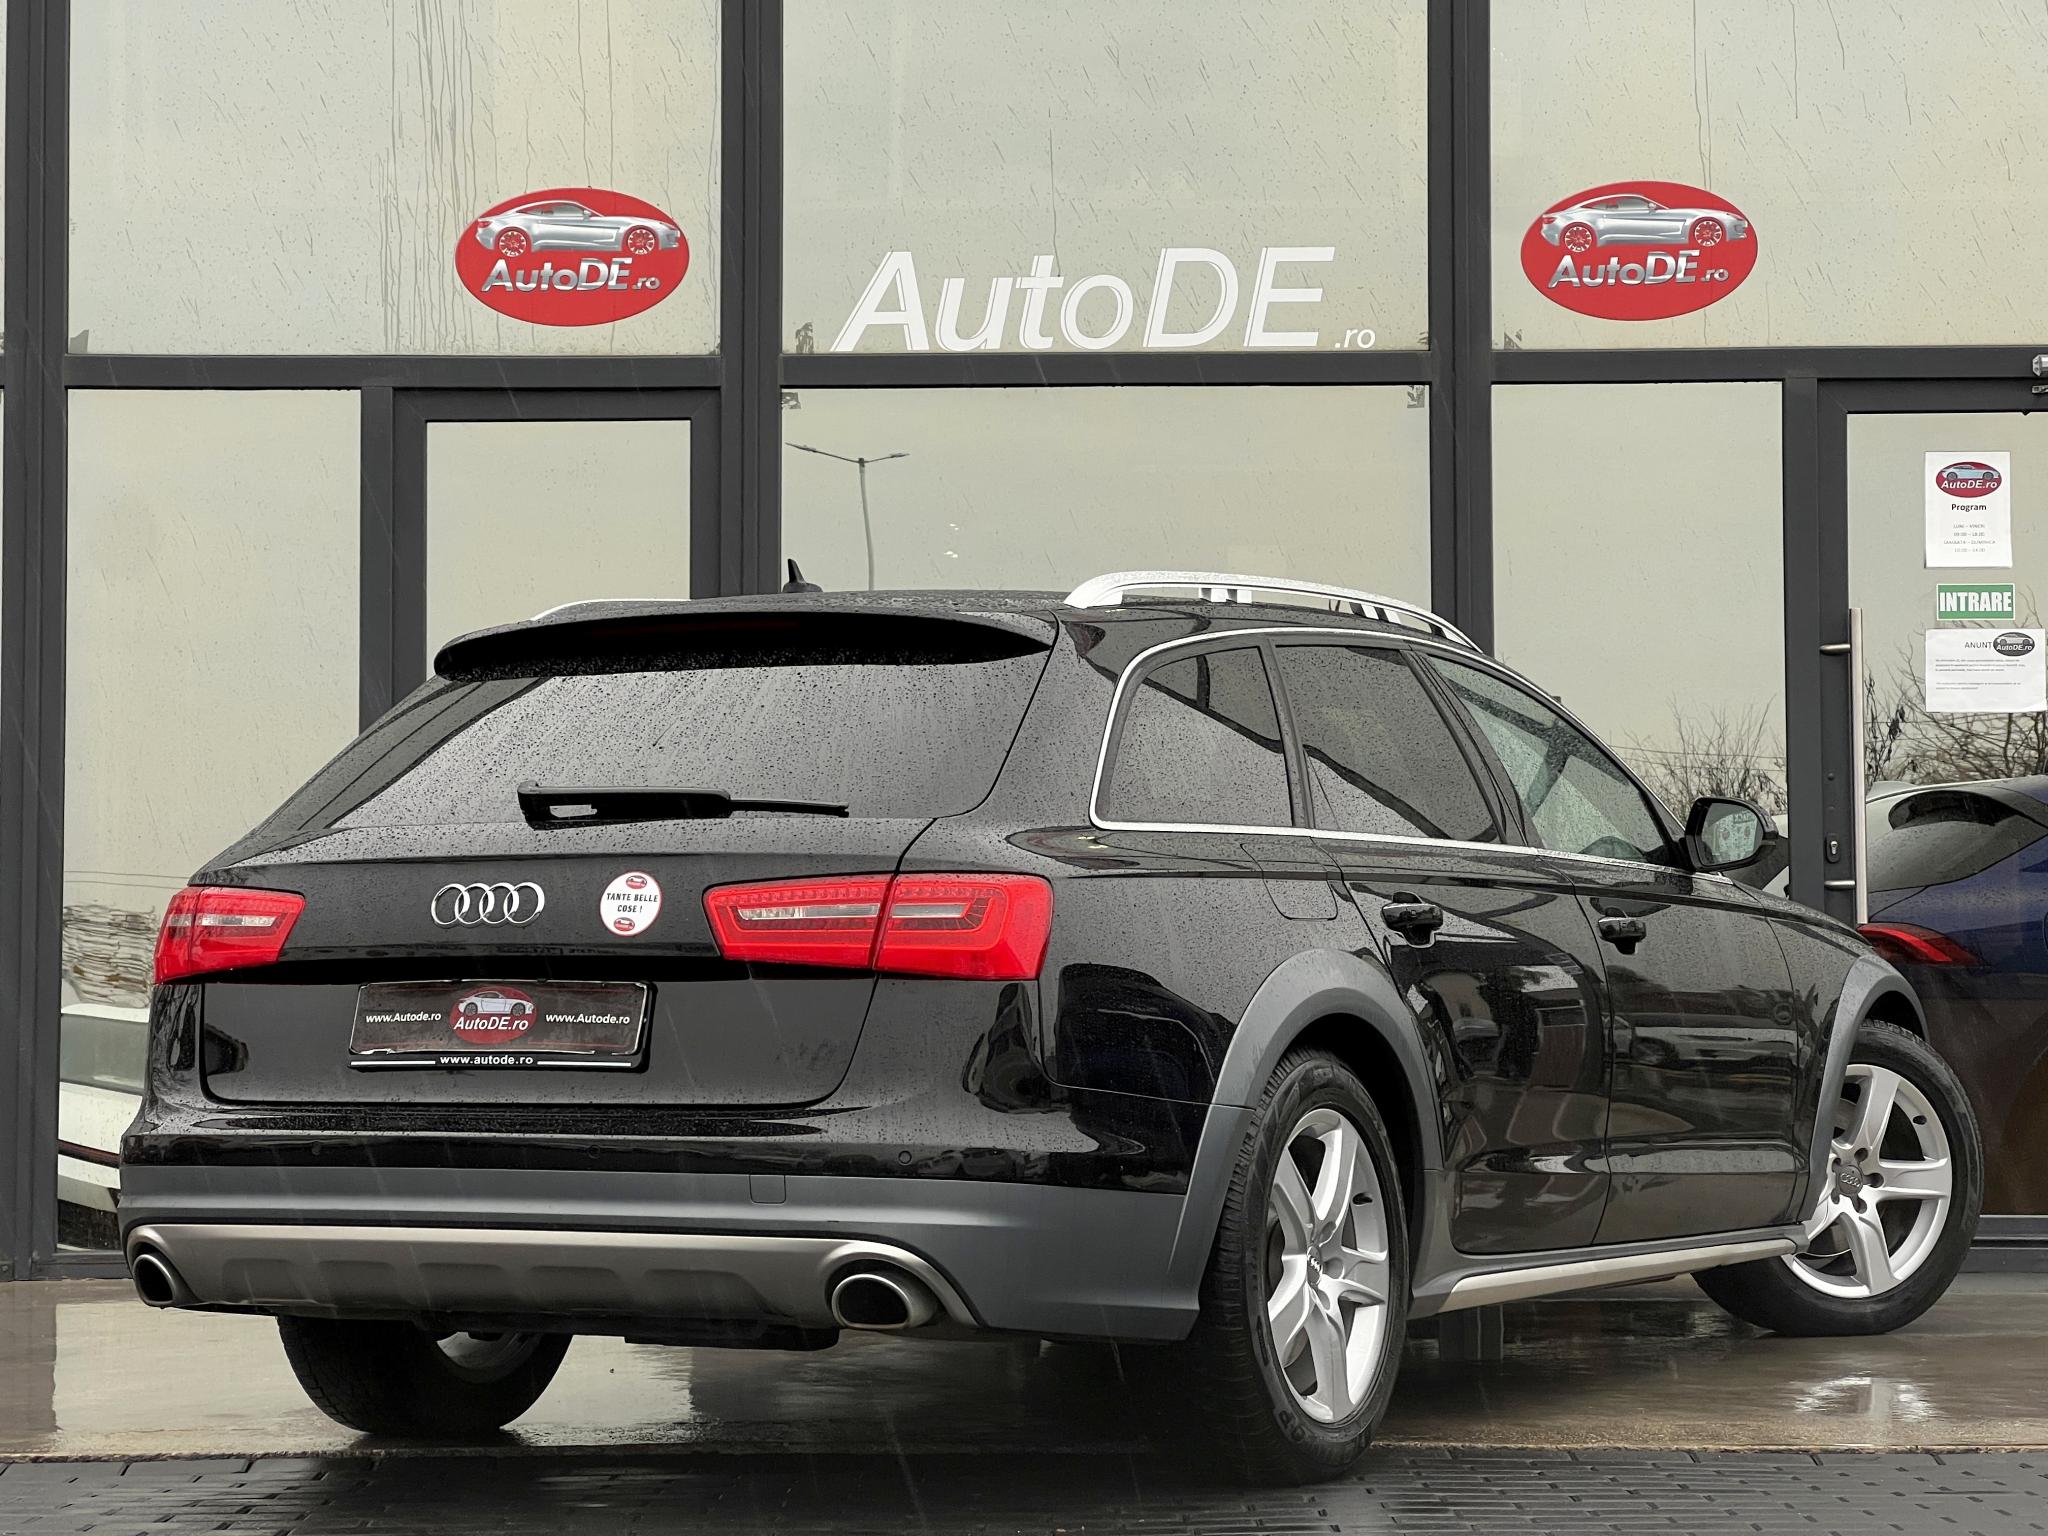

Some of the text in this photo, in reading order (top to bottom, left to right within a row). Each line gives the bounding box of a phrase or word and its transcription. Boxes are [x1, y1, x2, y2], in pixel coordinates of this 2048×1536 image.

[1941, 479, 1998, 489] AutoDE.ro
[1951, 503, 1987, 512] Program
[1939, 591, 2012, 612] INTRARE
[606, 892, 659, 902] TANTE BELLE
[617, 904, 637, 913] COSE
[365, 1011, 442, 1023] www.Autode.ro
[545, 1012, 631, 1025] www.Autode.ro
[453, 1016, 529, 1031] AutoDE.ro
[439, 1054, 534, 1066] www.autode.ro
